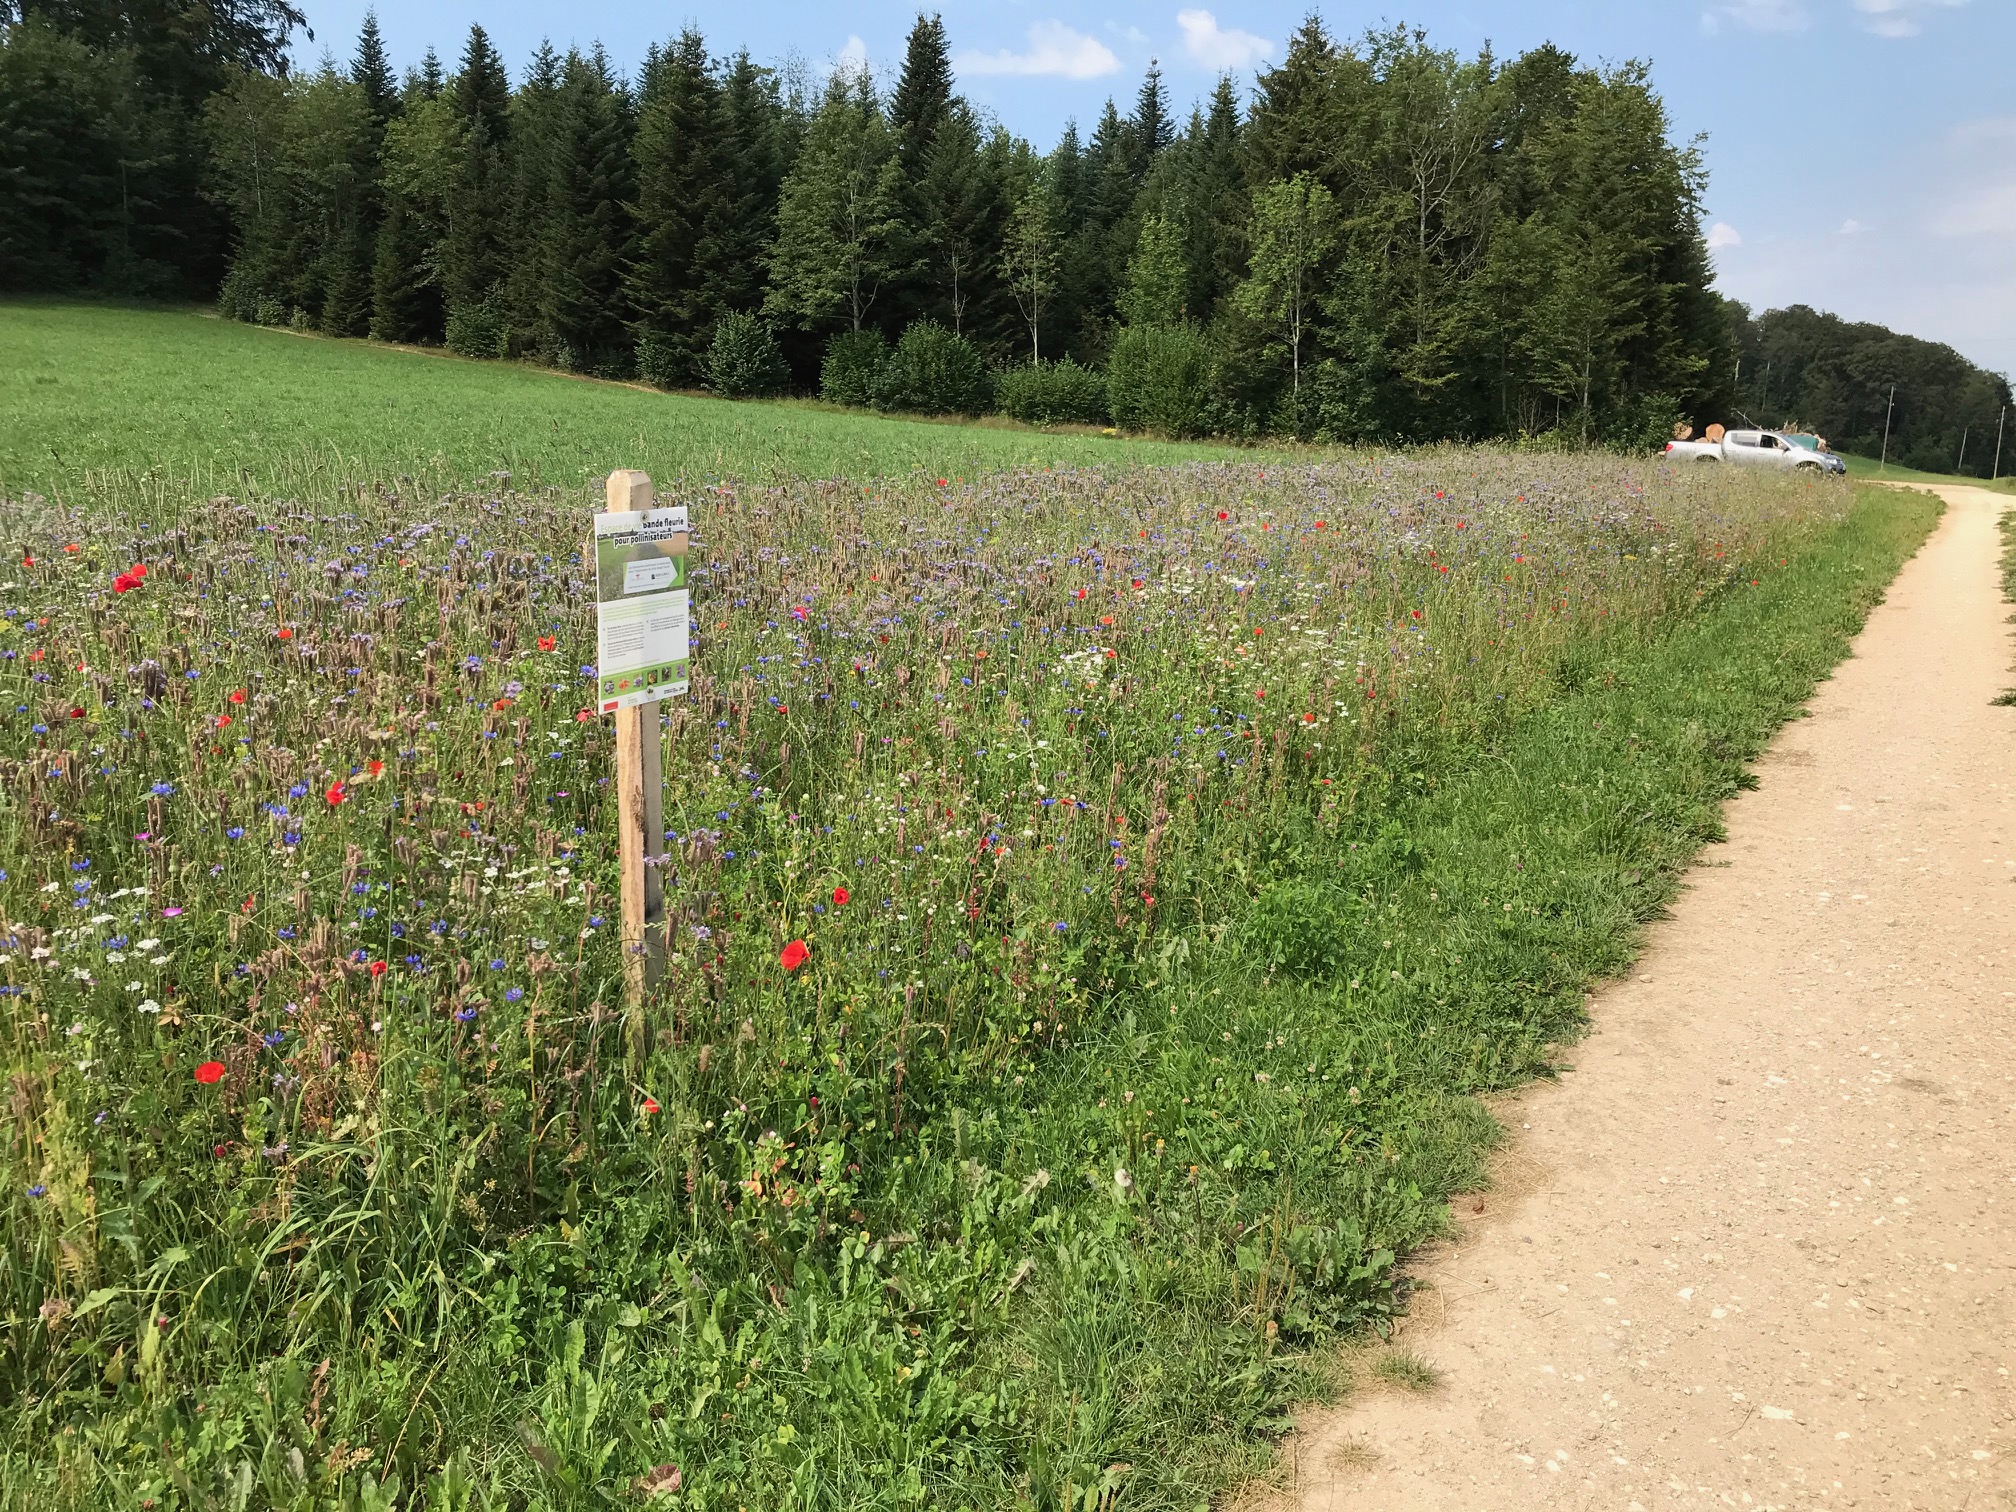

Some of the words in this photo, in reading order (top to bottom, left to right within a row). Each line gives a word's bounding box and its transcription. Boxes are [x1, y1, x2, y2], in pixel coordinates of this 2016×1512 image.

[664, 516, 684, 527] fleurie
[614, 537, 630, 547] pour
[631, 532, 672, 545] pollinisateurs
